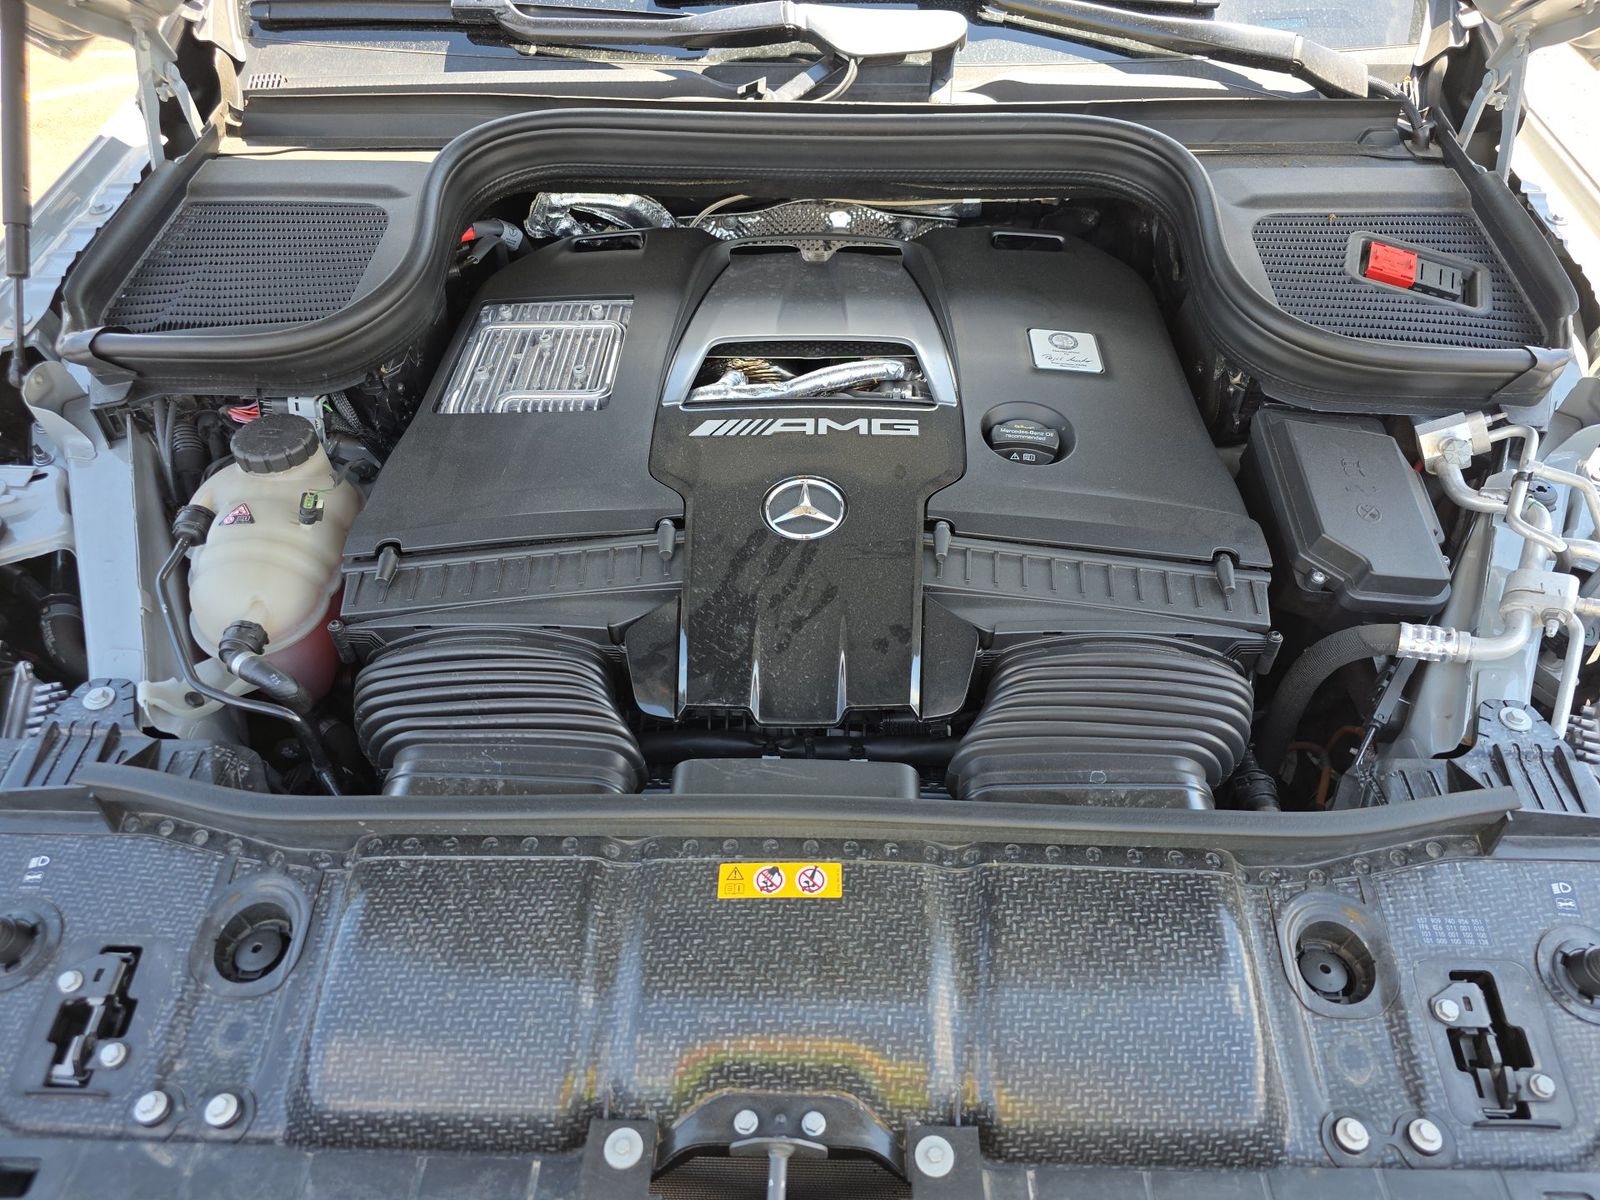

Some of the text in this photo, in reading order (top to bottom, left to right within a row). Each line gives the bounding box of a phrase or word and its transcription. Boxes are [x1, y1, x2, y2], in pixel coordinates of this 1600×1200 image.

[762, 418, 919, 436] AMG
[1000, 427, 1045, 437] Mercedes-Benz
[1005, 433, 1046, 441] recommended
